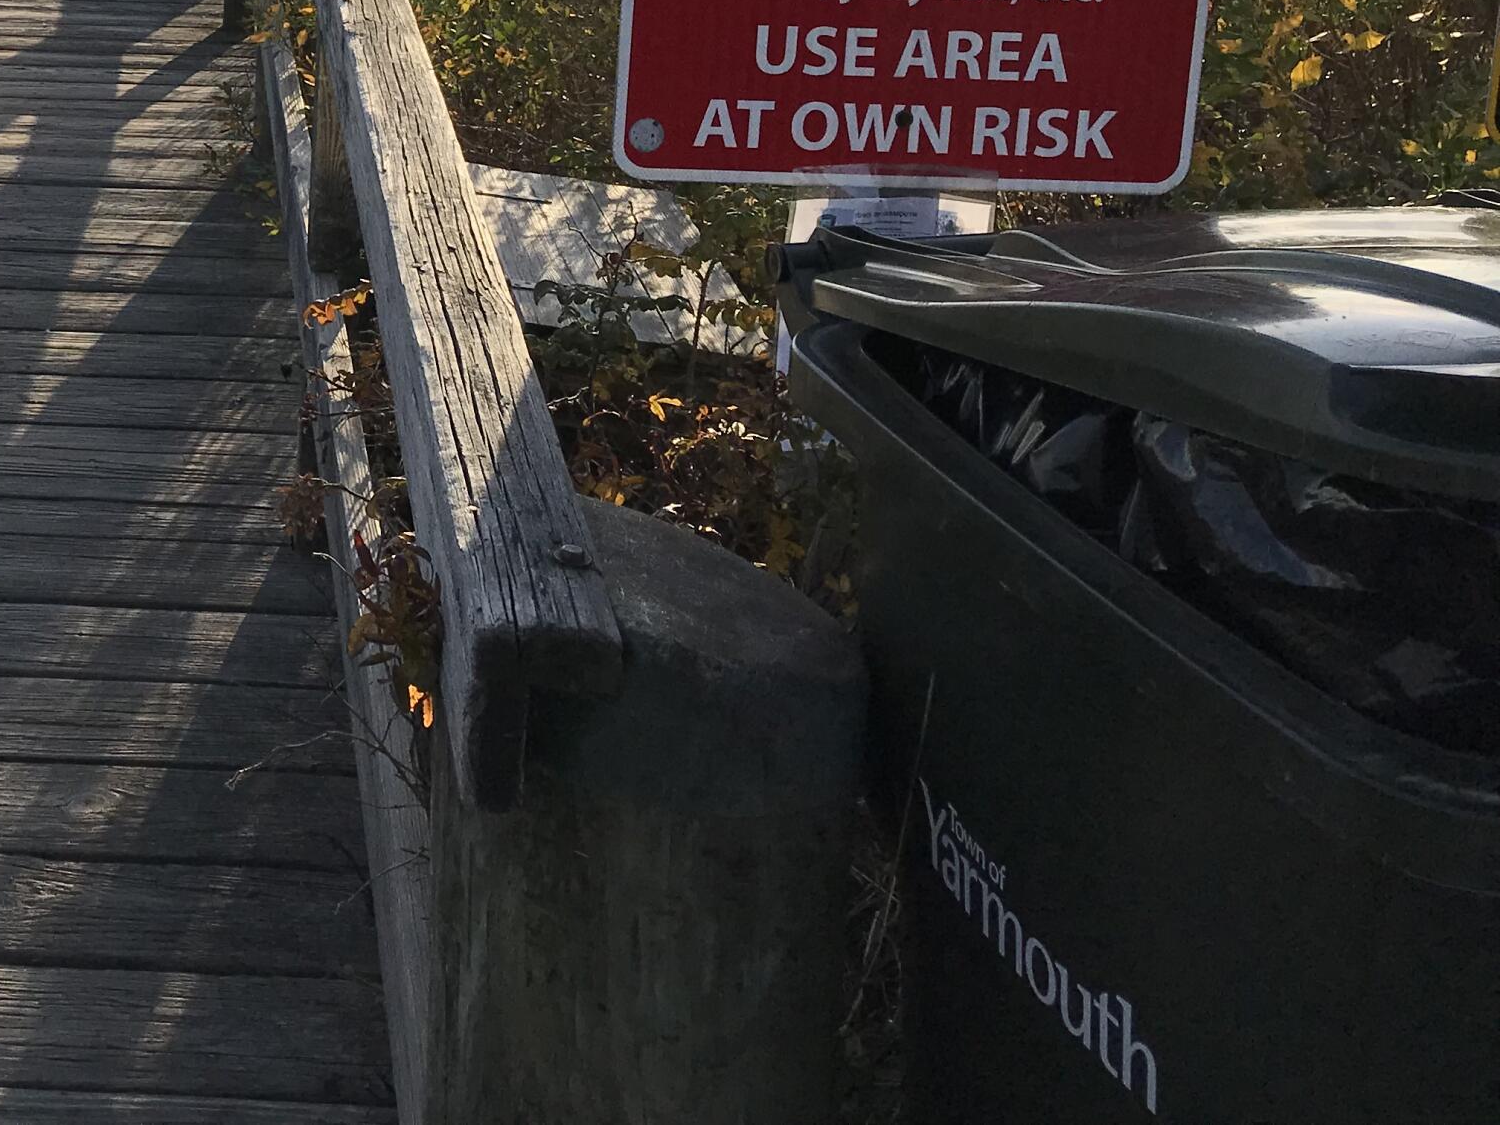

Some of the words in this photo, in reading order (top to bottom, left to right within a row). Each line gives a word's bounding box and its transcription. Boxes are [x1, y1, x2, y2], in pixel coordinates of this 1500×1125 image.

[755, 24, 878, 77] USE
[893, 29, 1069, 83] AREA
[692, 98, 776, 149] AT
[791, 101, 953, 155] OWN
[971, 106, 1118, 159] RISK
[947, 802, 986, 866] Town
[989, 861, 1006, 890] of
[919, 777, 1157, 1115] Yarmouth
